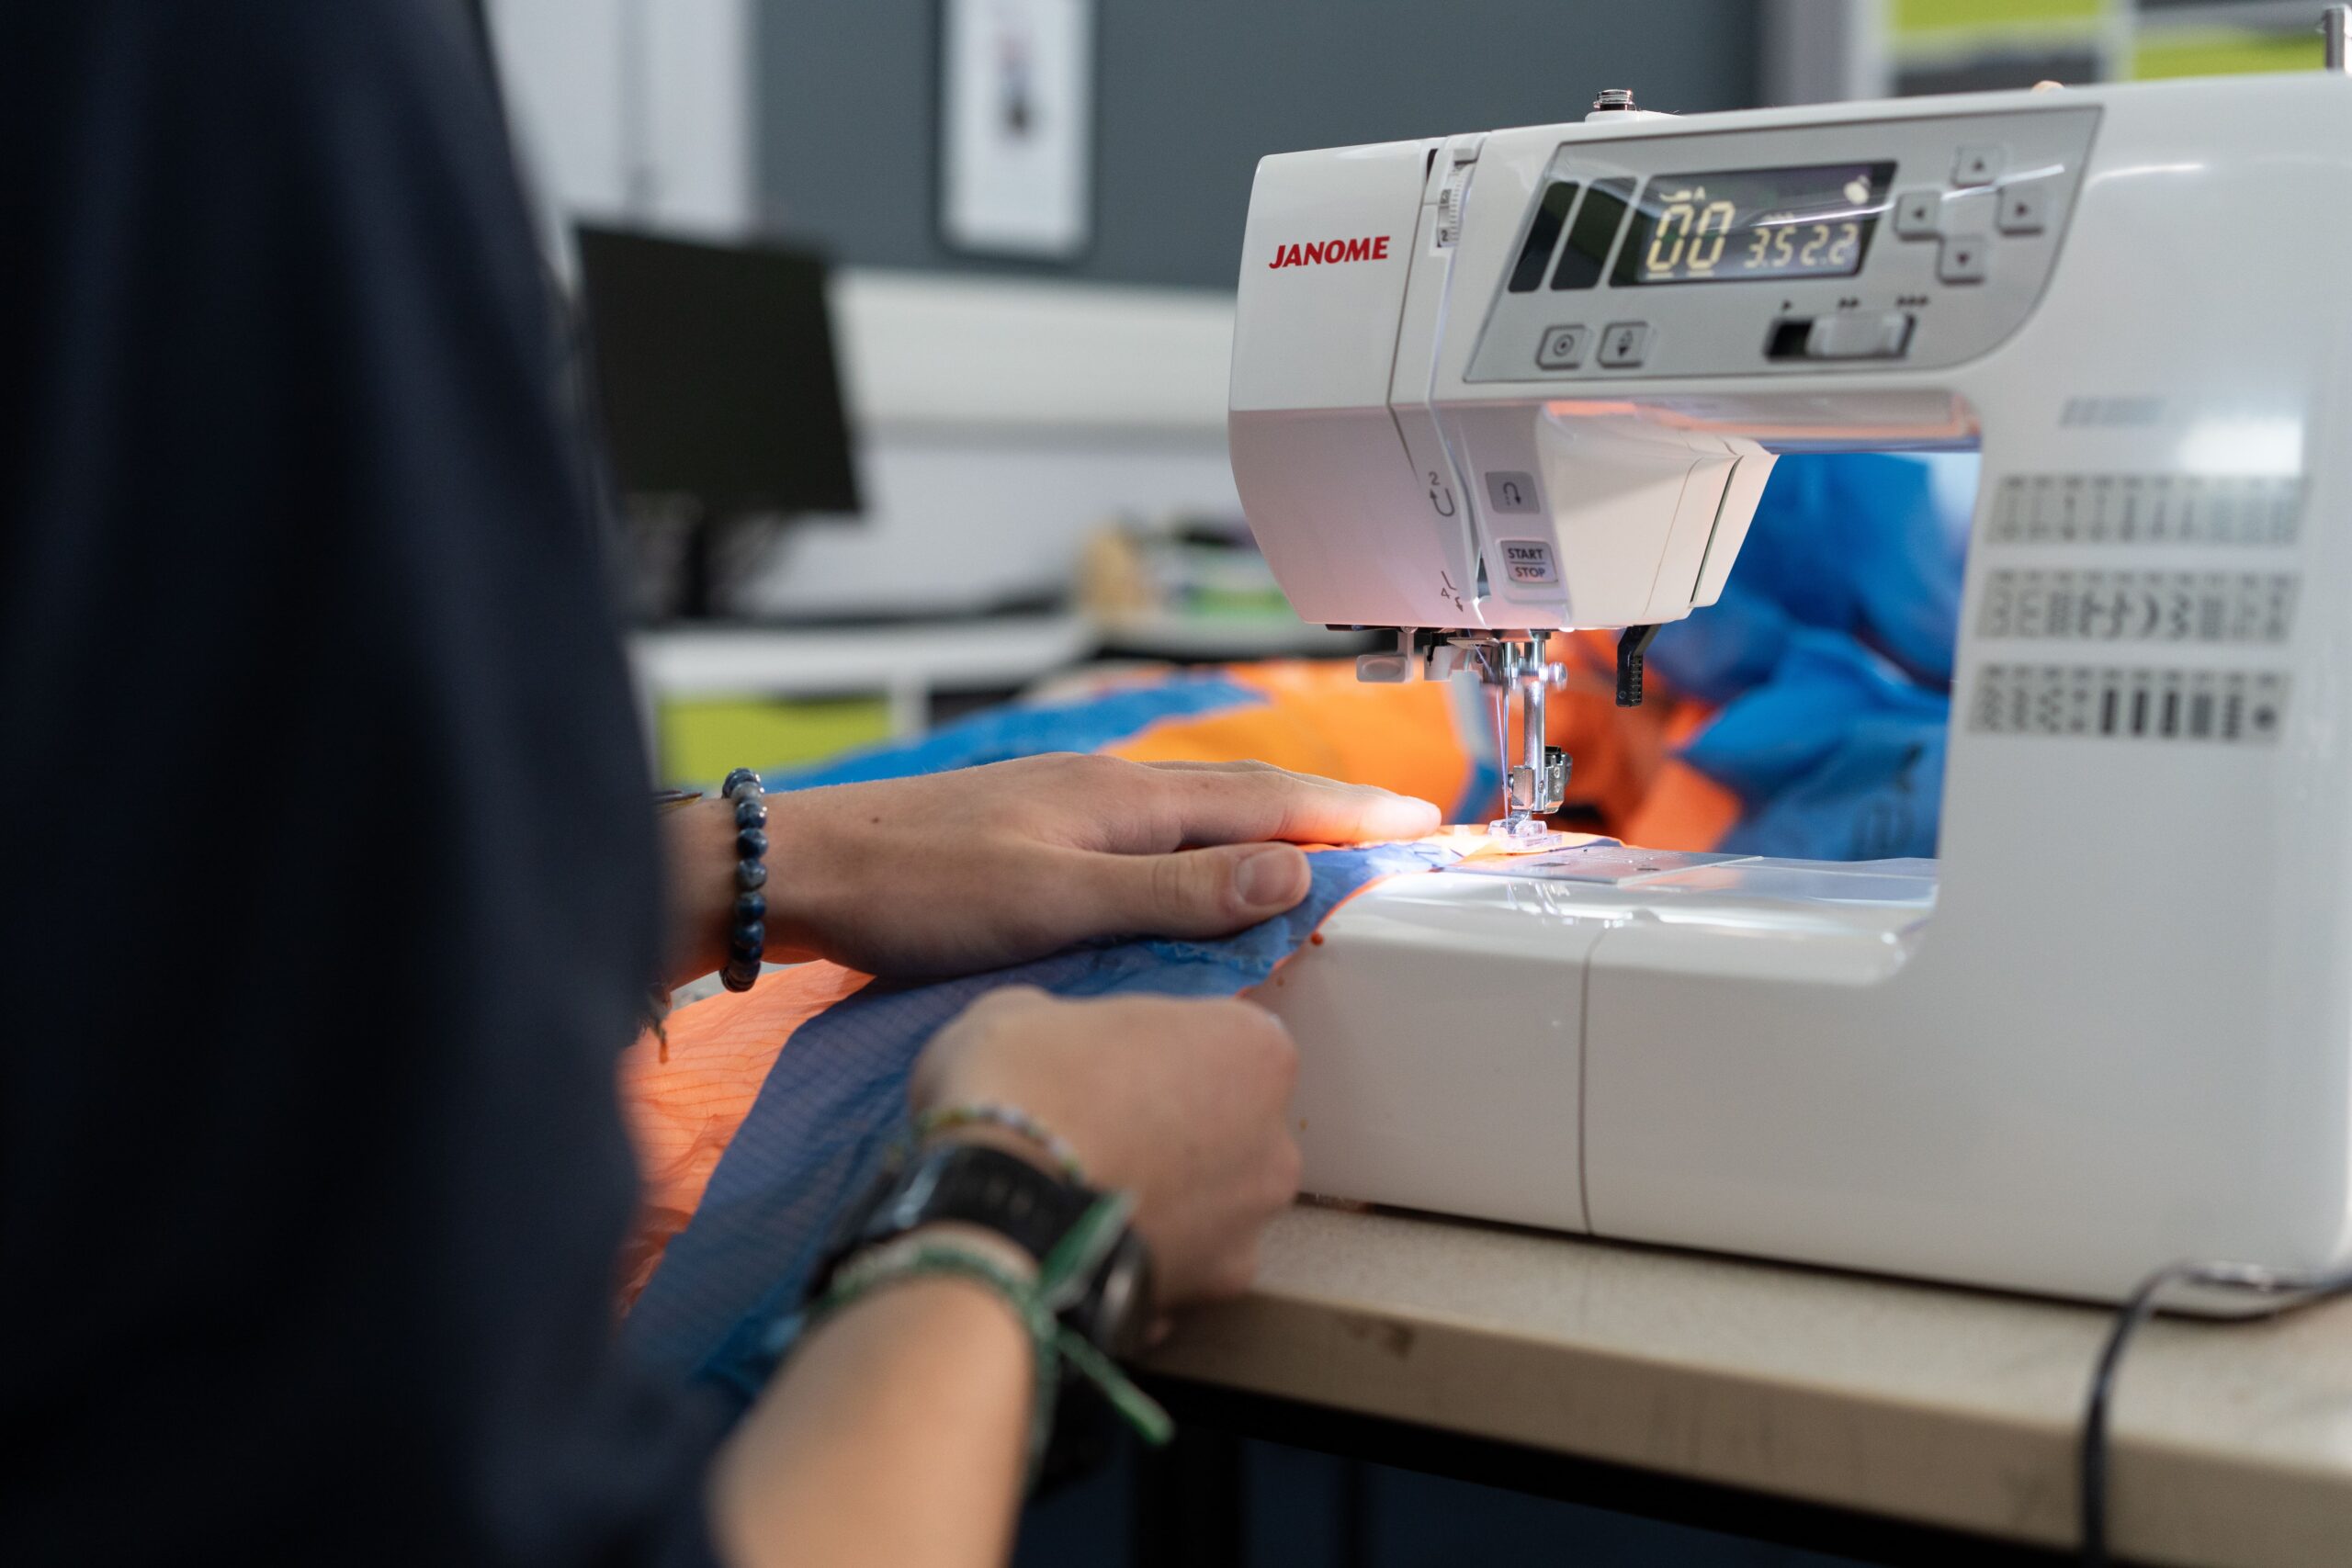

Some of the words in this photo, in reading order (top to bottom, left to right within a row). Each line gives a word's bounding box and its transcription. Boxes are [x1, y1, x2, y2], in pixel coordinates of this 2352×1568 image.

[1441, 229, 1449, 242] 2
[1645, 200, 1736, 272] 00
[1269, 235, 1391, 269] JANOME
[1428, 470, 1441, 486] 2
[1508, 547, 1544, 559] START
[1514, 566, 1545, 578] STOP
[1441, 587, 1451, 600] 4
